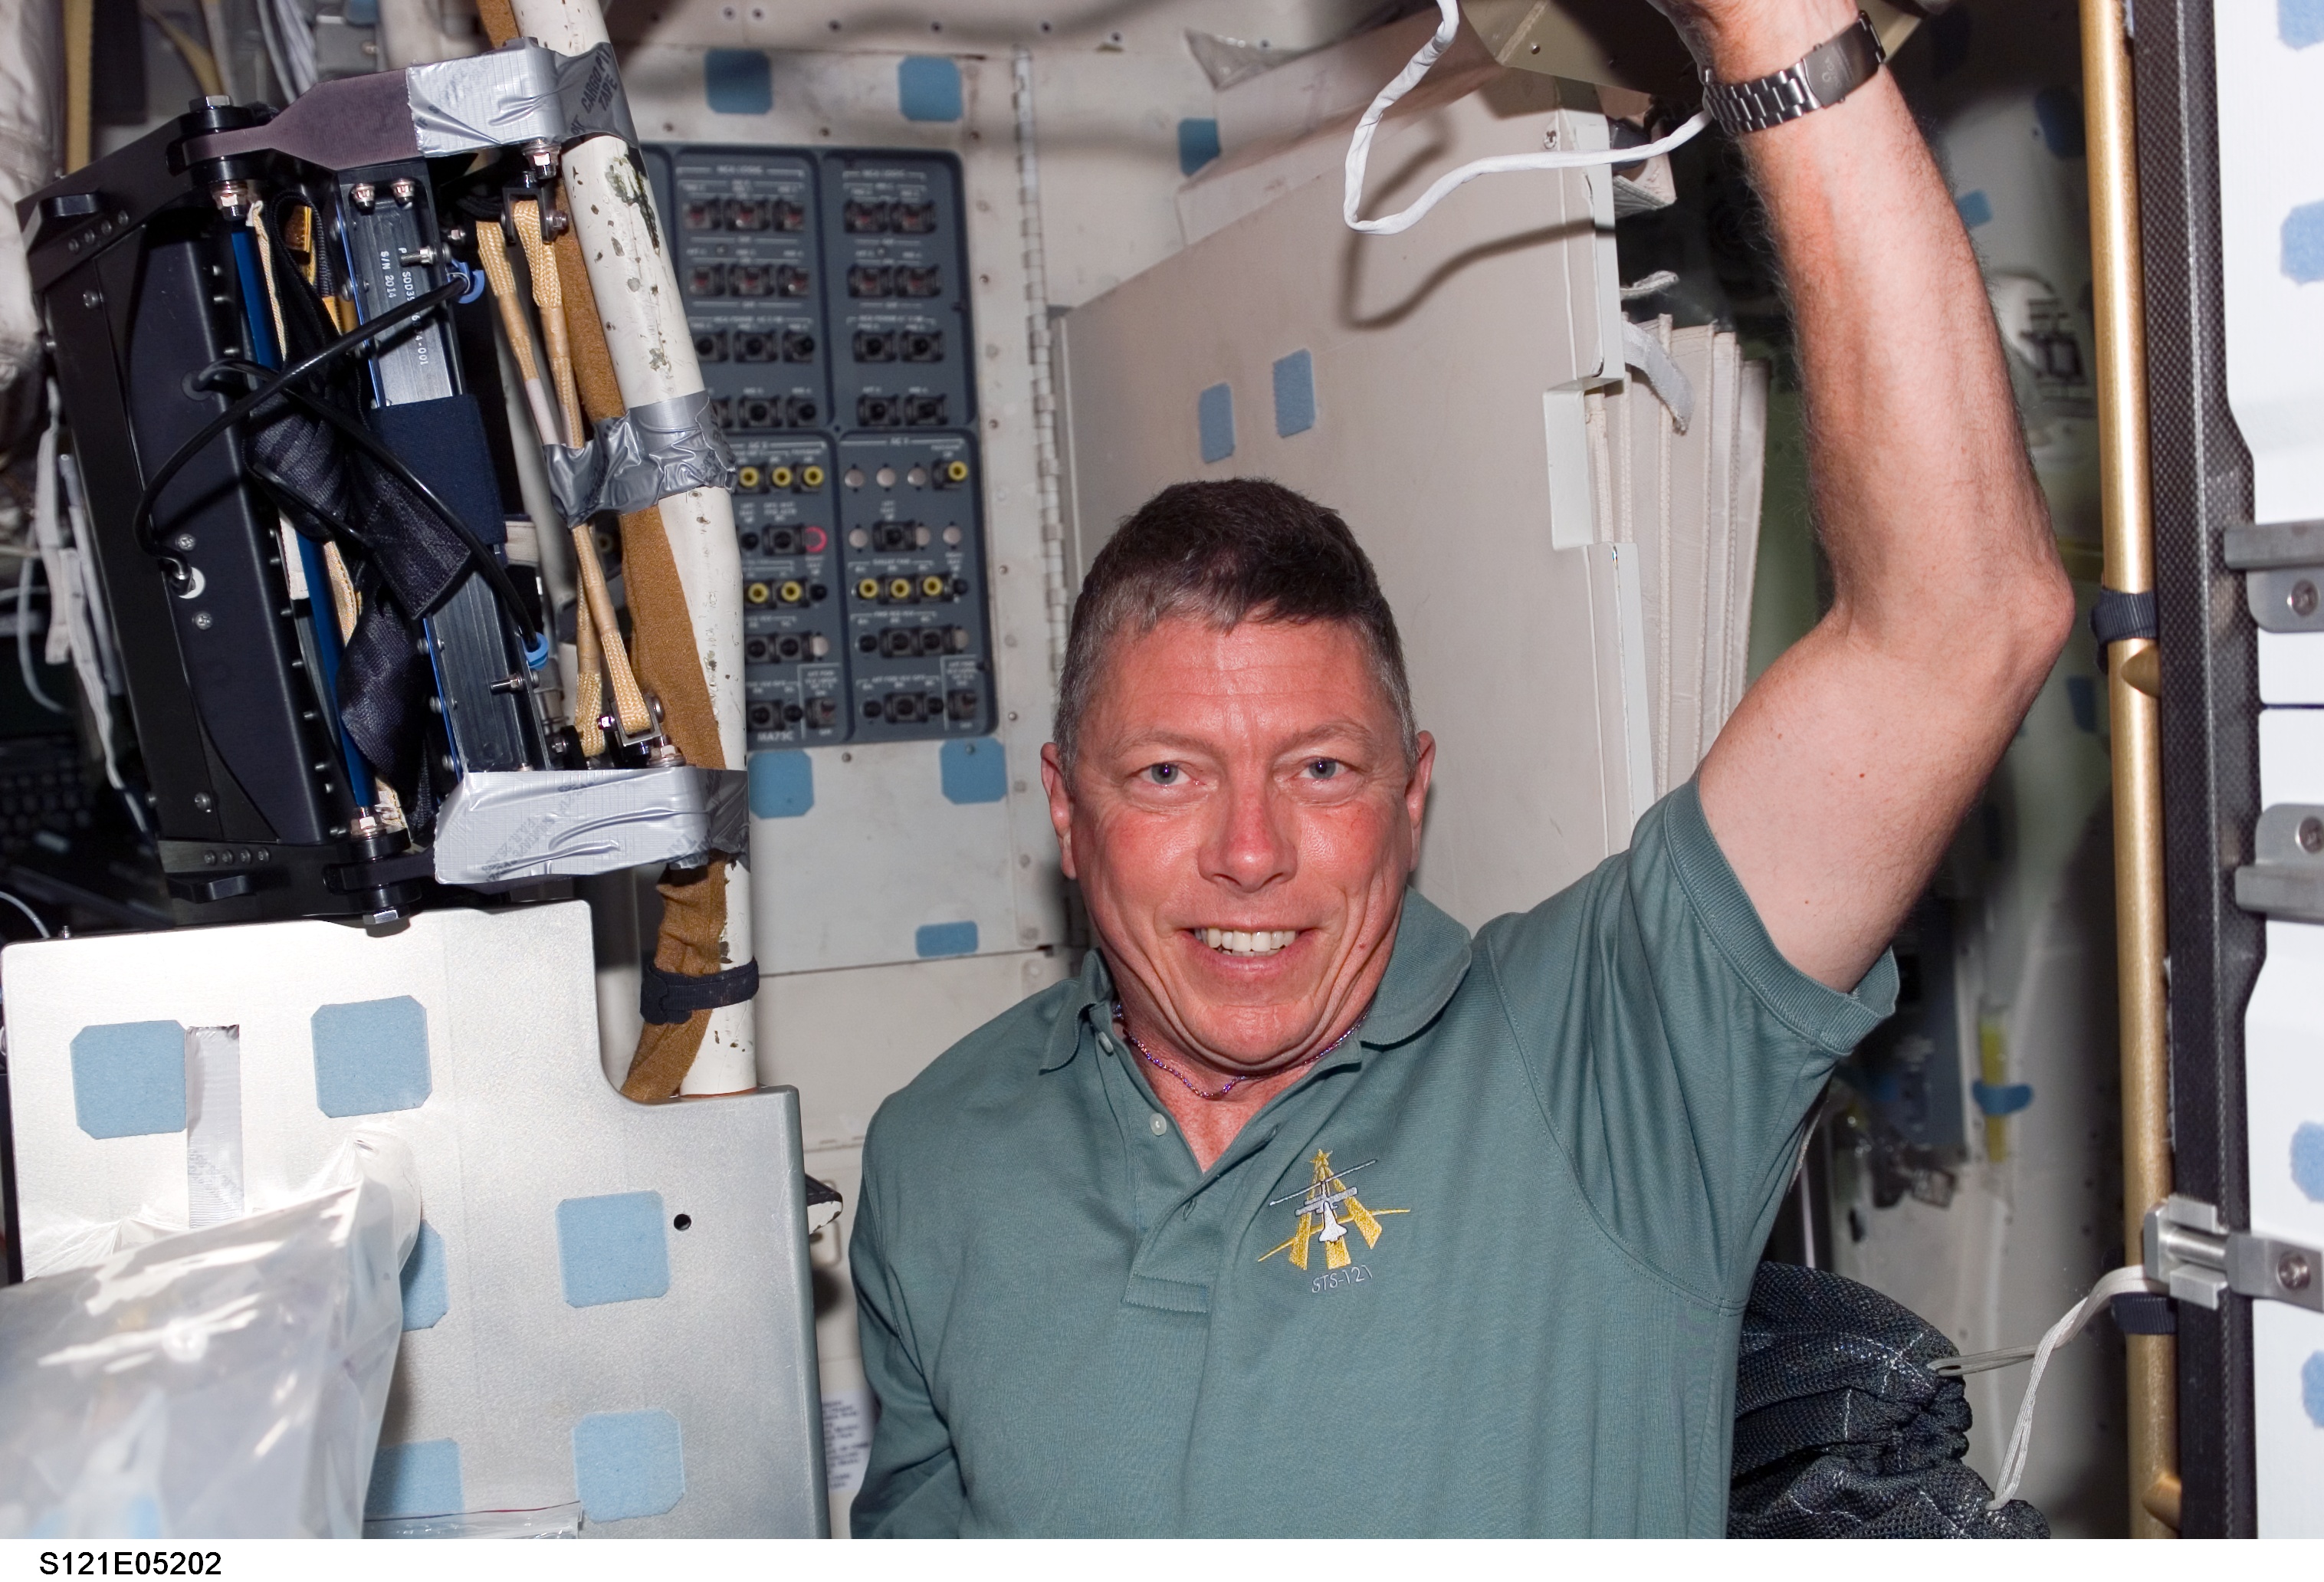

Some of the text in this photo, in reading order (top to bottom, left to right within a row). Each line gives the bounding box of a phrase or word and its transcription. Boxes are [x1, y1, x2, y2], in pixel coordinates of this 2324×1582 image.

[580, 66, 602, 114] CARGO
[598, 74, 619, 111] TAPE
[385, 274, 396, 298] 2014
[757, 730, 795, 742] MA73C
[1311, 1265, 1373, 1292] STS-121
